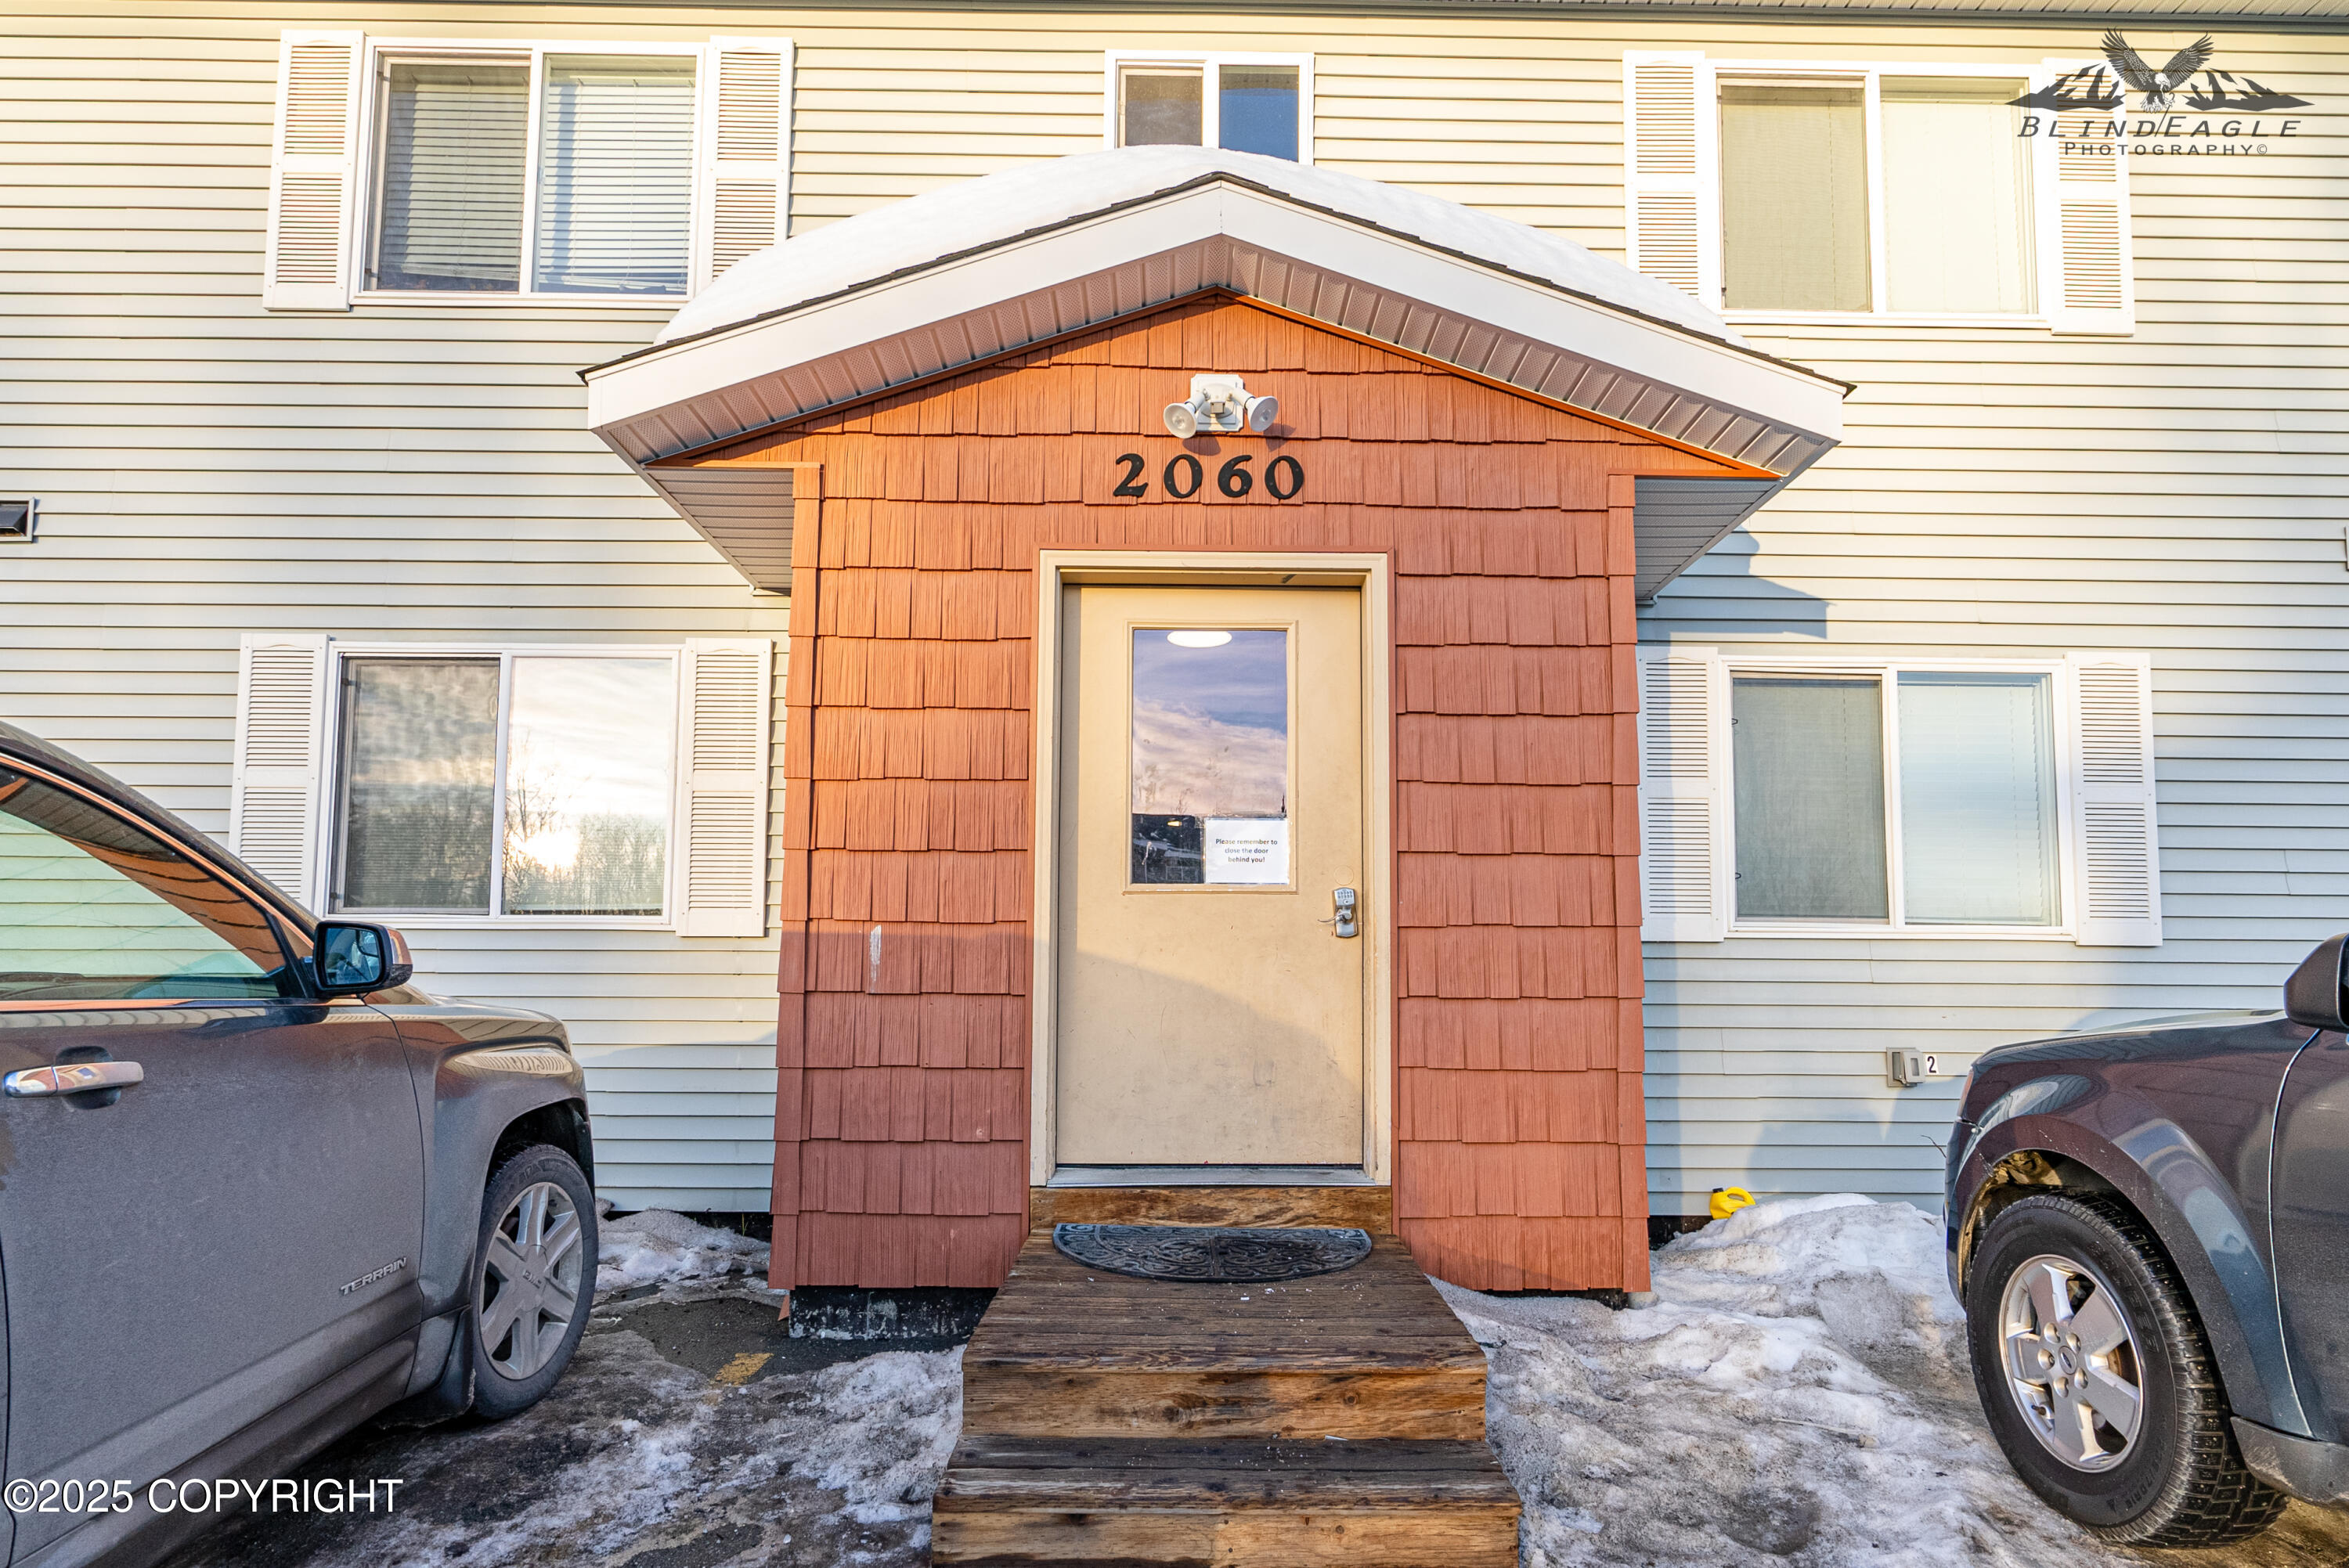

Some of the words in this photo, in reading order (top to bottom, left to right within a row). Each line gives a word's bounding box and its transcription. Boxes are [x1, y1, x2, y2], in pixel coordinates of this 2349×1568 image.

[1113, 452, 1304, 499] 2060
[1927, 1055, 1937, 1073] 2
[339, 1257, 406, 1296] TERRAIN
